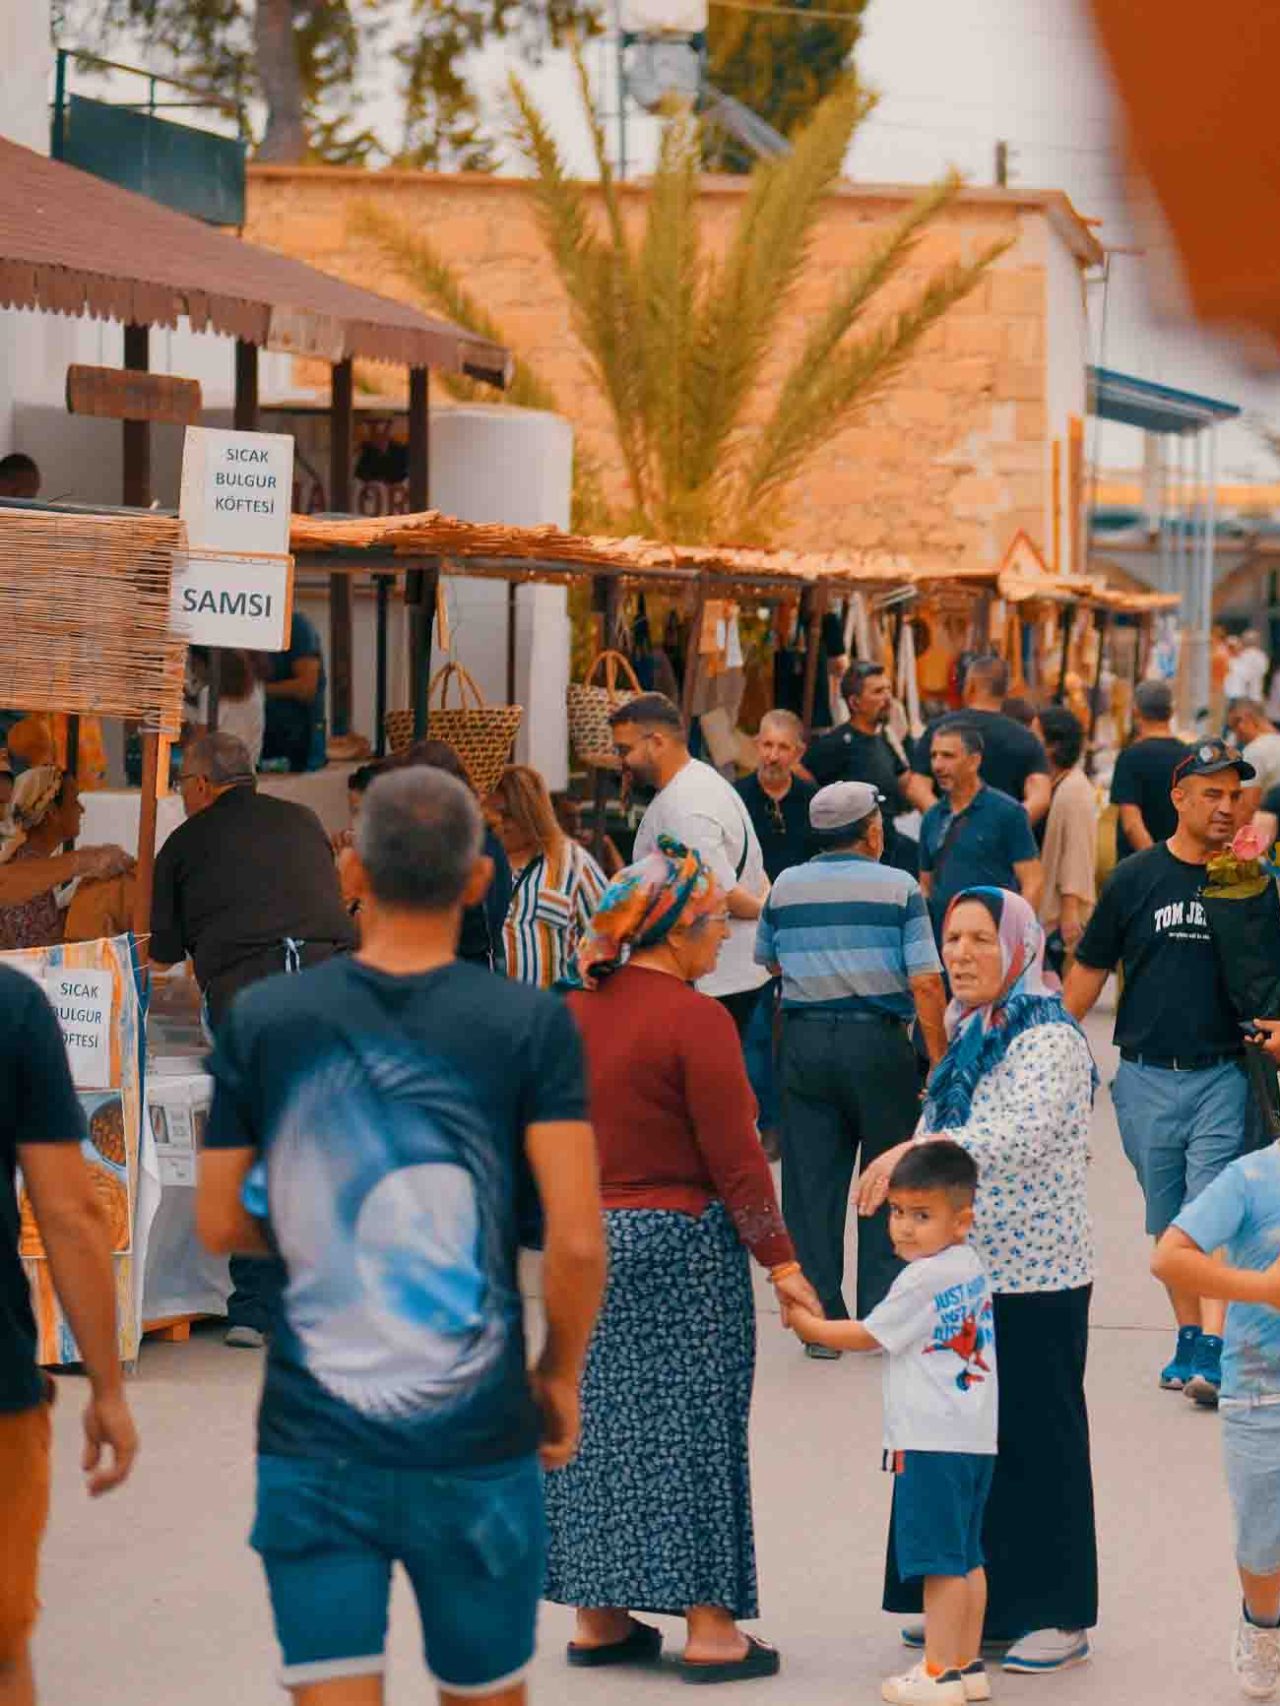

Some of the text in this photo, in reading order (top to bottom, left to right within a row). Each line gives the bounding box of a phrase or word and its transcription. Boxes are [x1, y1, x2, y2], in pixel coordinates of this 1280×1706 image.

[226, 448, 269, 463] SICAK
[215, 472, 277, 489] BULGUR
[215, 496, 274, 514] KÖFTESİ
[183, 588, 272, 618] SAMSI
[1154, 901, 1184, 933] TOM
[60, 982, 99, 998] SICAK
